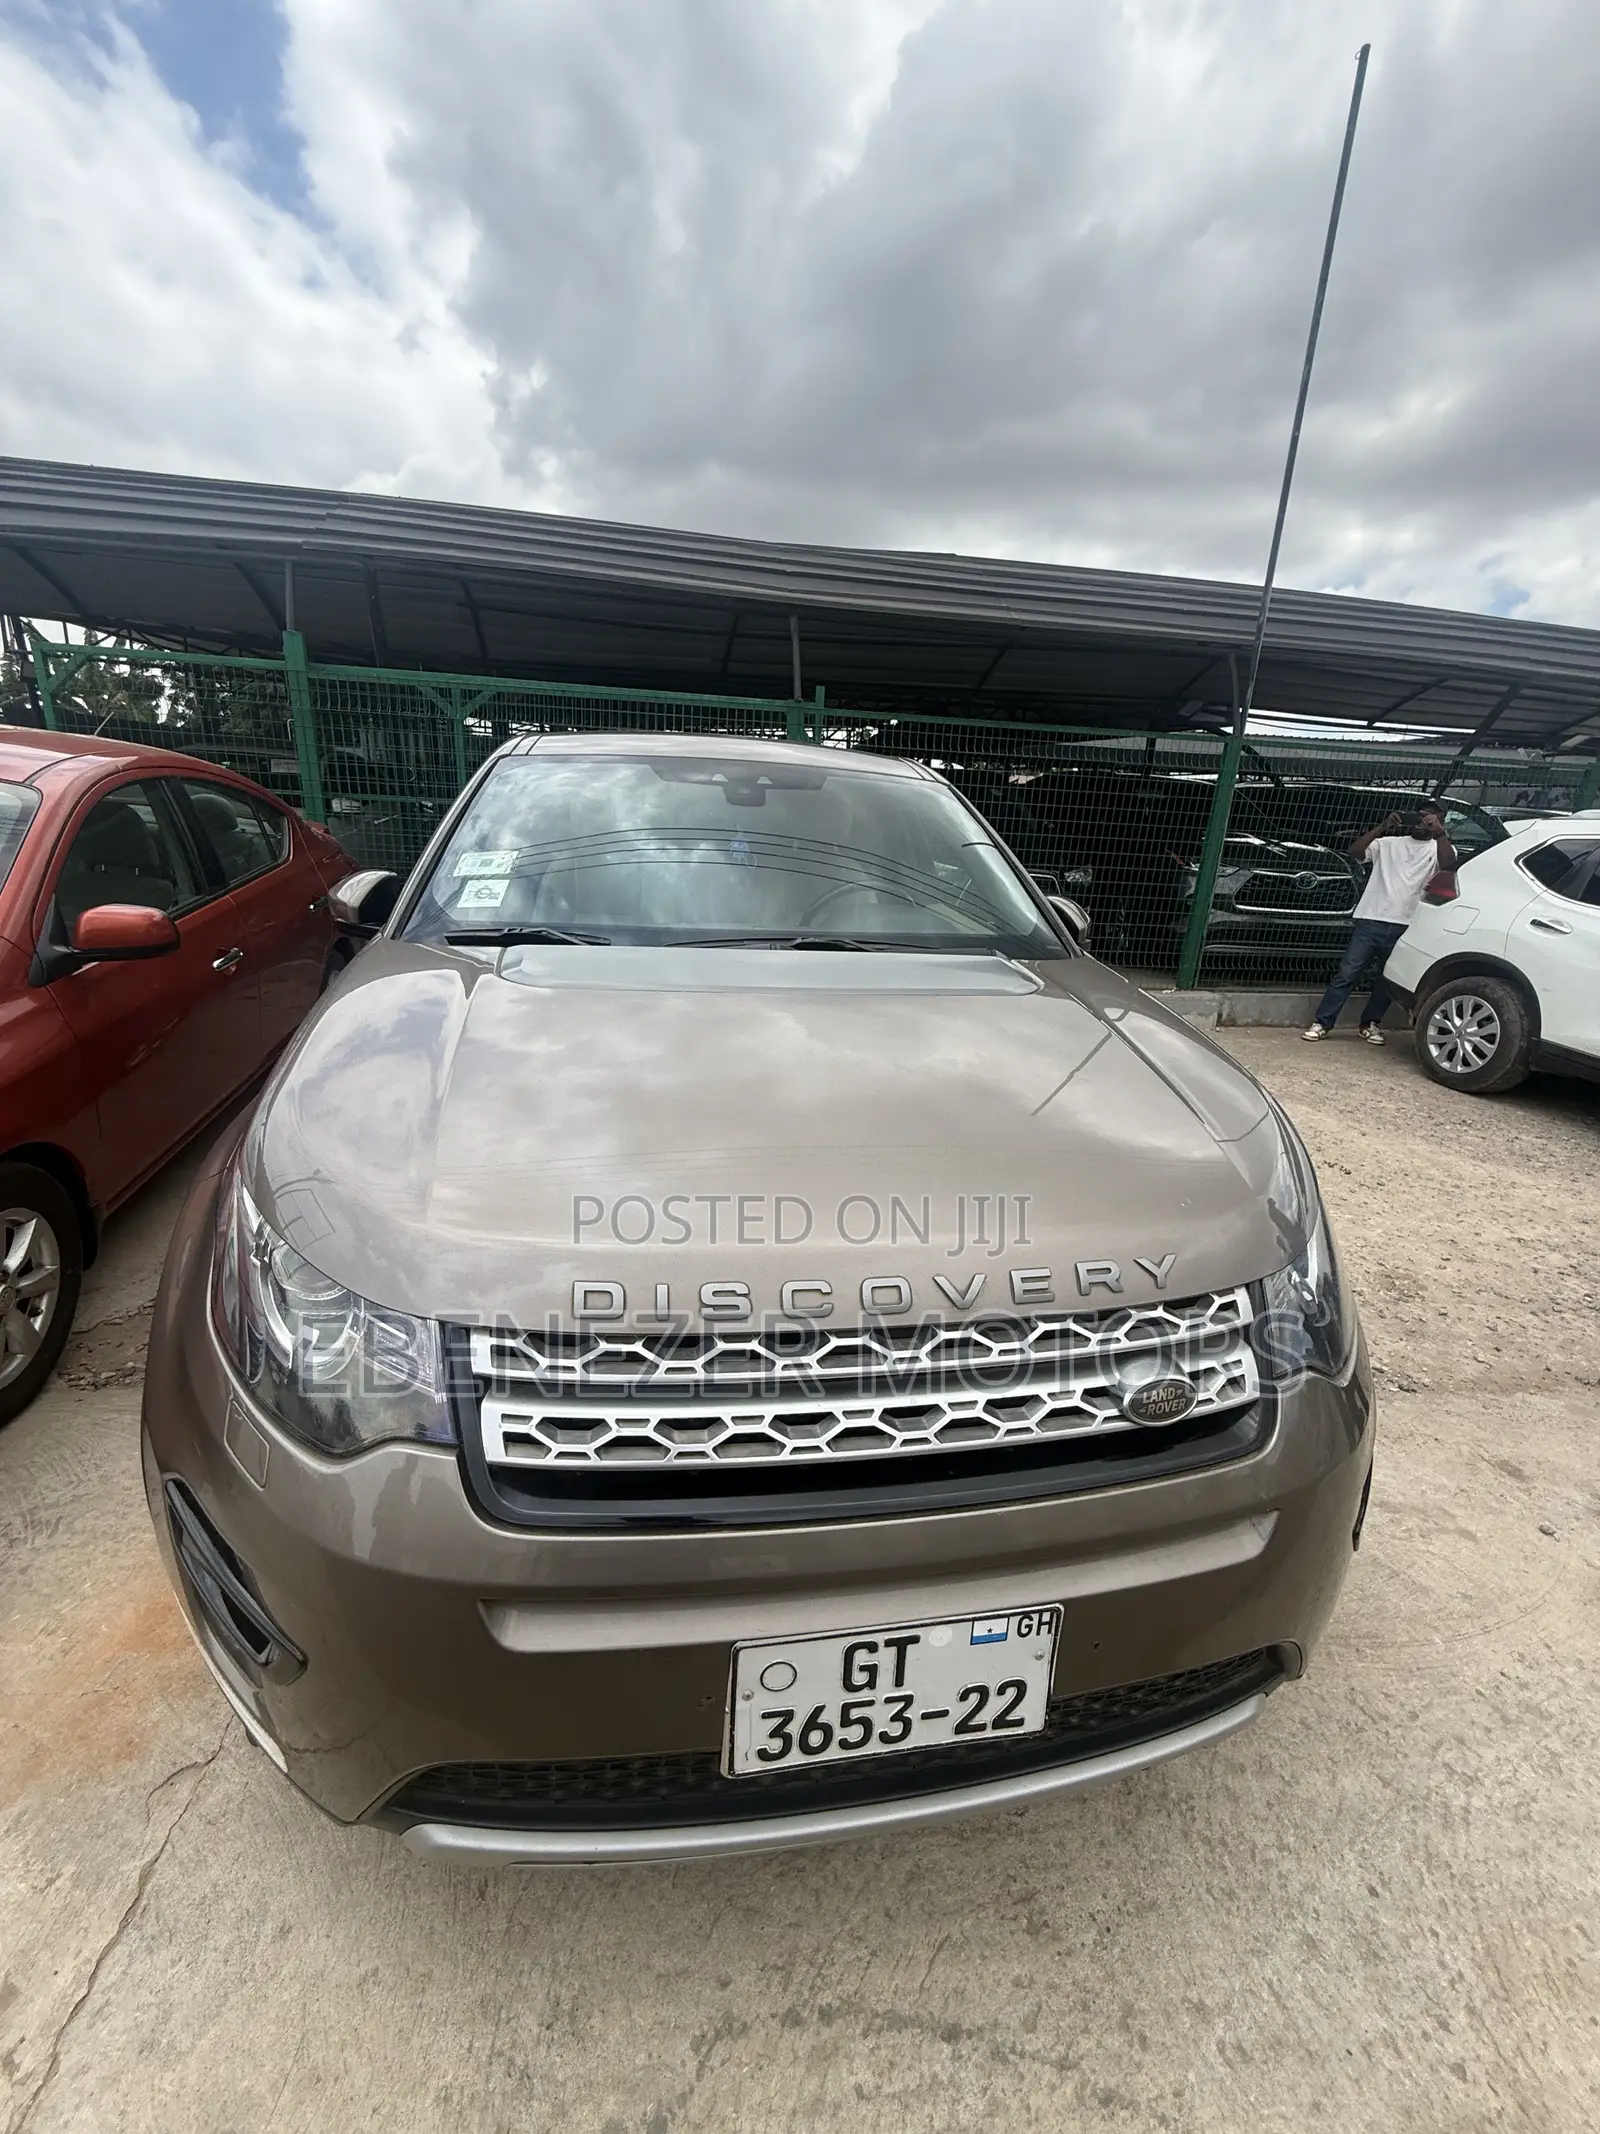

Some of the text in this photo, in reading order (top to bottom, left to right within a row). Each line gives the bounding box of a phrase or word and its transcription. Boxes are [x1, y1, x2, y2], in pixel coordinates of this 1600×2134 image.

[572, 1253, 1178, 1321] DISCOVERY
[1143, 1387, 1176, 1404] LAND
[1146, 1398, 1187, 1416] ROVER
[1016, 1613, 1052, 1638] GH
[841, 1633, 921, 1692] GT
[756, 1677, 1028, 1762] 3653-22
